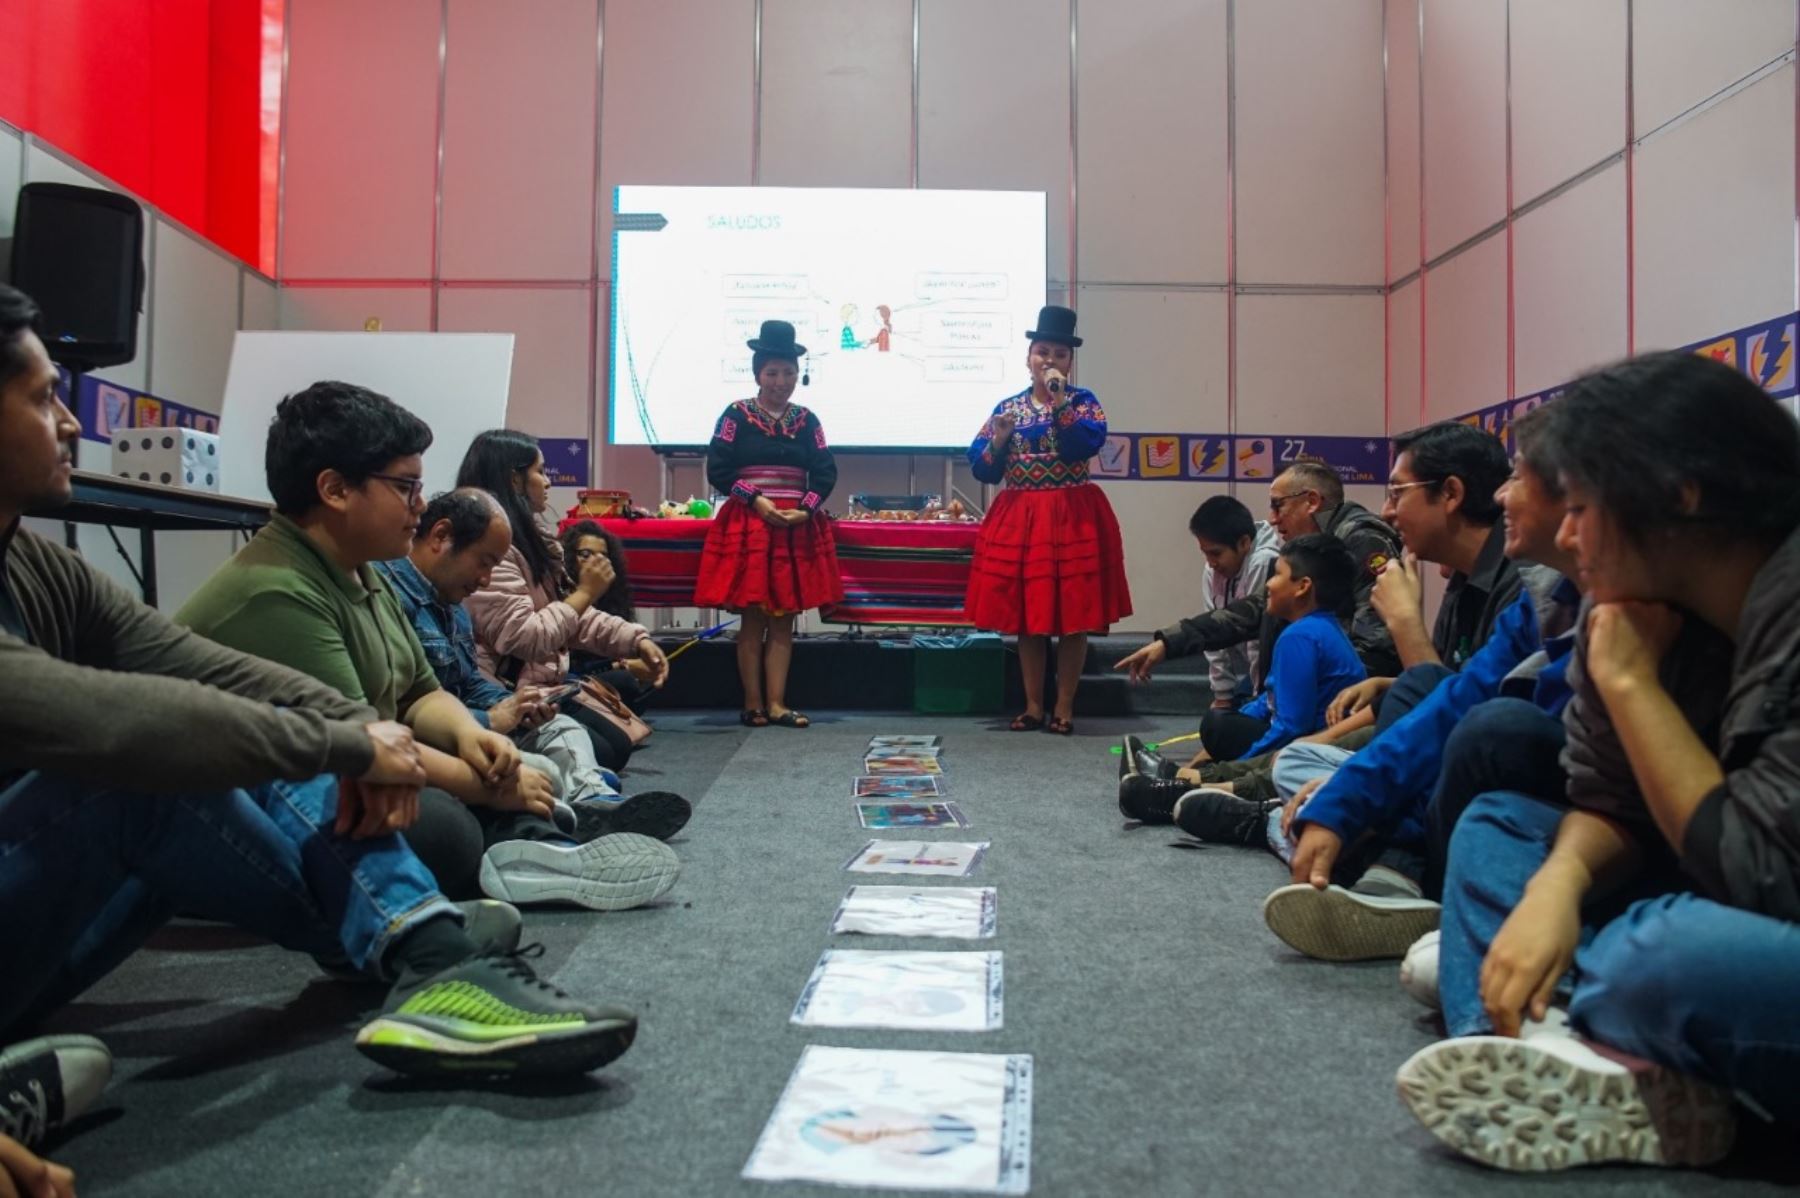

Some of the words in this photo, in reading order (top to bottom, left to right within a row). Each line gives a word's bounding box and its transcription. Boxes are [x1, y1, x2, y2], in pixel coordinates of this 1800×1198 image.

[707, 214, 782, 230] SALUDOS
[1280, 439, 1306, 461] 27
[1351, 473, 1374, 481] LIMA
